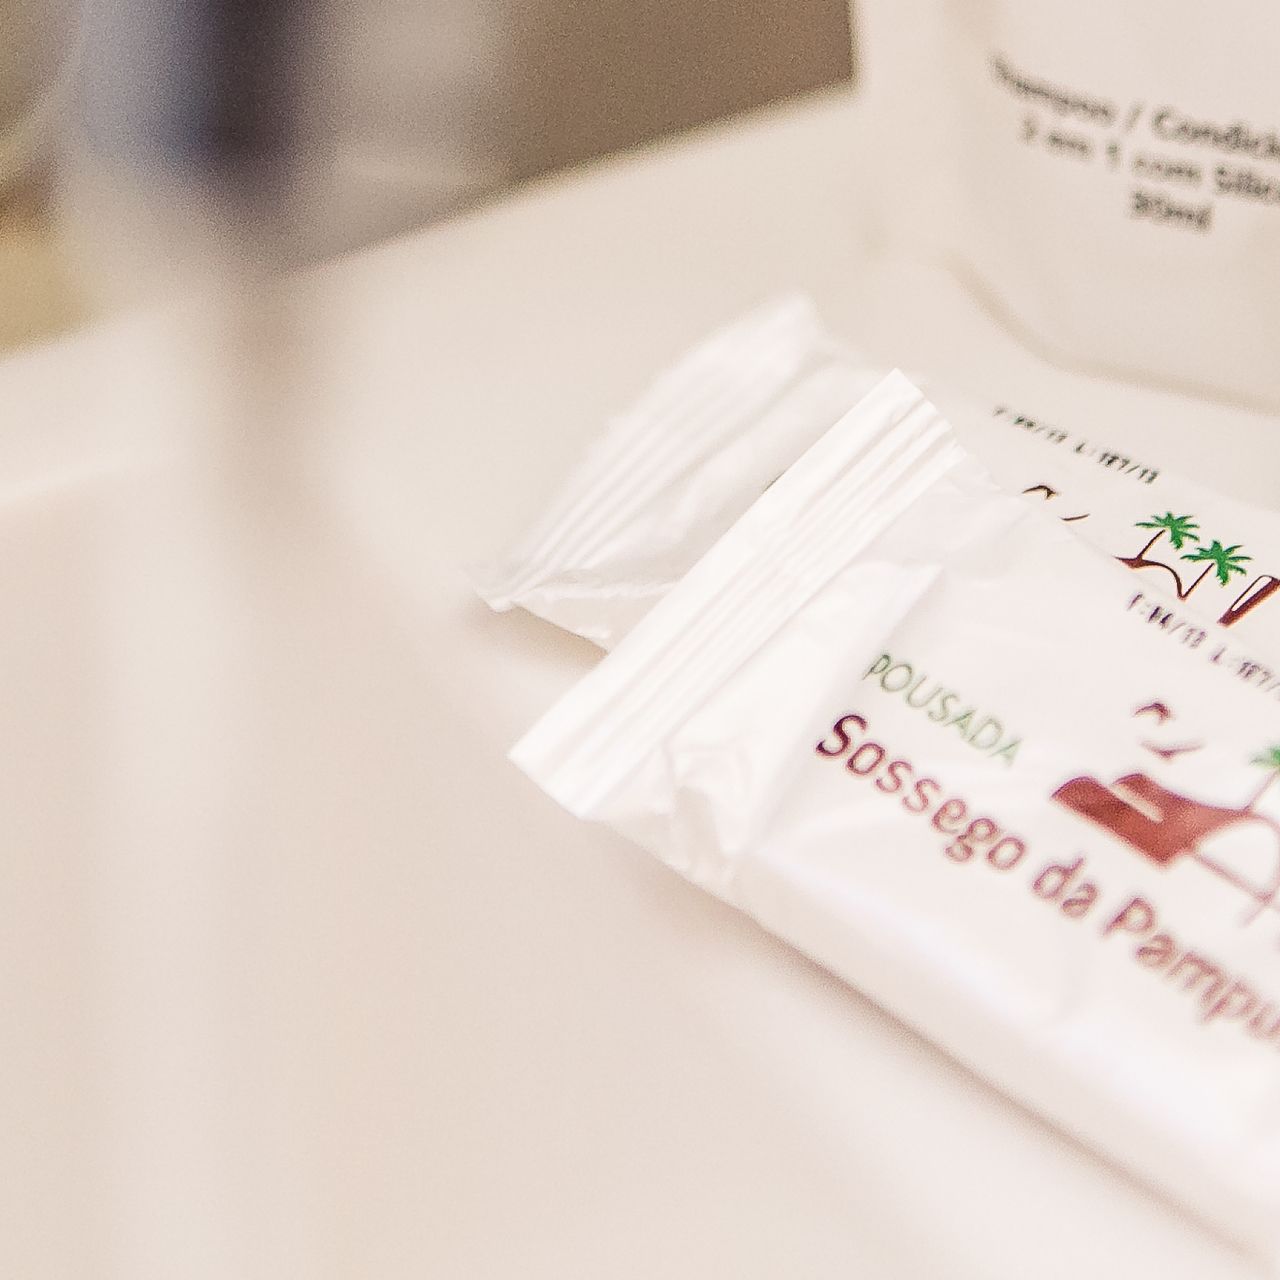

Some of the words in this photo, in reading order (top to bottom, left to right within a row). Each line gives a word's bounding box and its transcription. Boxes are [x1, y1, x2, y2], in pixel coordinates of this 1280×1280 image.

[864, 651, 1023, 767] POUSADA
[816, 713, 1027, 872] Sossego
[1032, 856, 1100, 918] da
